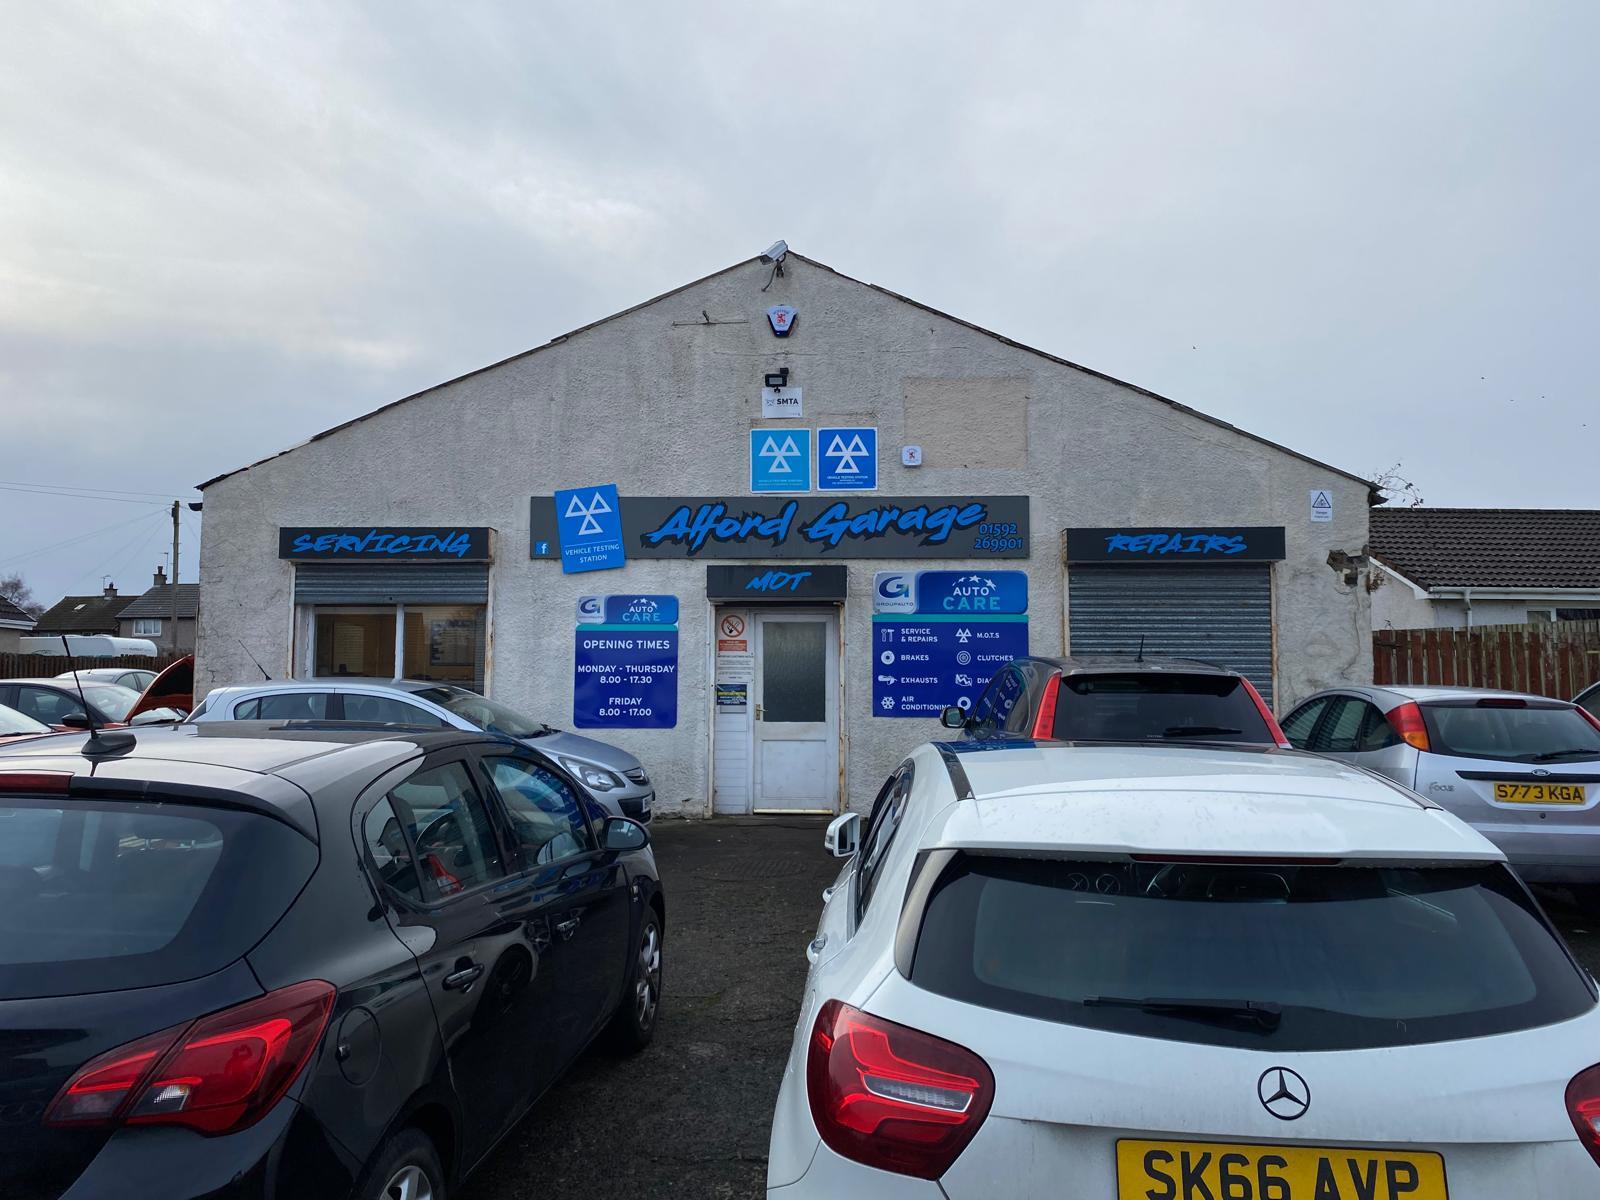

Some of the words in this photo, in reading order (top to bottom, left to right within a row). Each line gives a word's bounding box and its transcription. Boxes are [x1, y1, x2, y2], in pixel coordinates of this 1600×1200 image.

[648, 501, 799, 552] Alford
[804, 502, 987, 545] Garage
[979, 523, 1017, 537] 01592
[291, 528, 473, 558] SERVICING
[565, 546, 592, 556] VEHICLE
[592, 543, 620, 553] TESTING
[974, 537, 1023, 552] 269901
[1104, 532, 1248, 555] REPAIRS
[579, 554, 608, 564] STATION
[746, 570, 812, 592] MOT
[953, 586, 990, 596] AUTO
[942, 597, 1001, 610] CARE
[622, 613, 661, 621] CARE
[583, 640, 634, 650] OPENING
[636, 640, 670, 650] TIMES
[577, 665, 617, 673] MONDAY
[625, 665, 675, 673] THURSDAY
[599, 676, 621, 684] 8.00
[629, 676, 652, 684] 17.30
[608, 697, 642, 705] FRIDAY
[599, 708, 620, 716] 8.00
[629, 708, 652, 716] 17.00
[1497, 784, 1544, 799] S773
[1549, 785, 1584, 801] KGA
[1143, 1150, 1292, 1200] SK66
[1312, 1157, 1419, 1200] AVP
